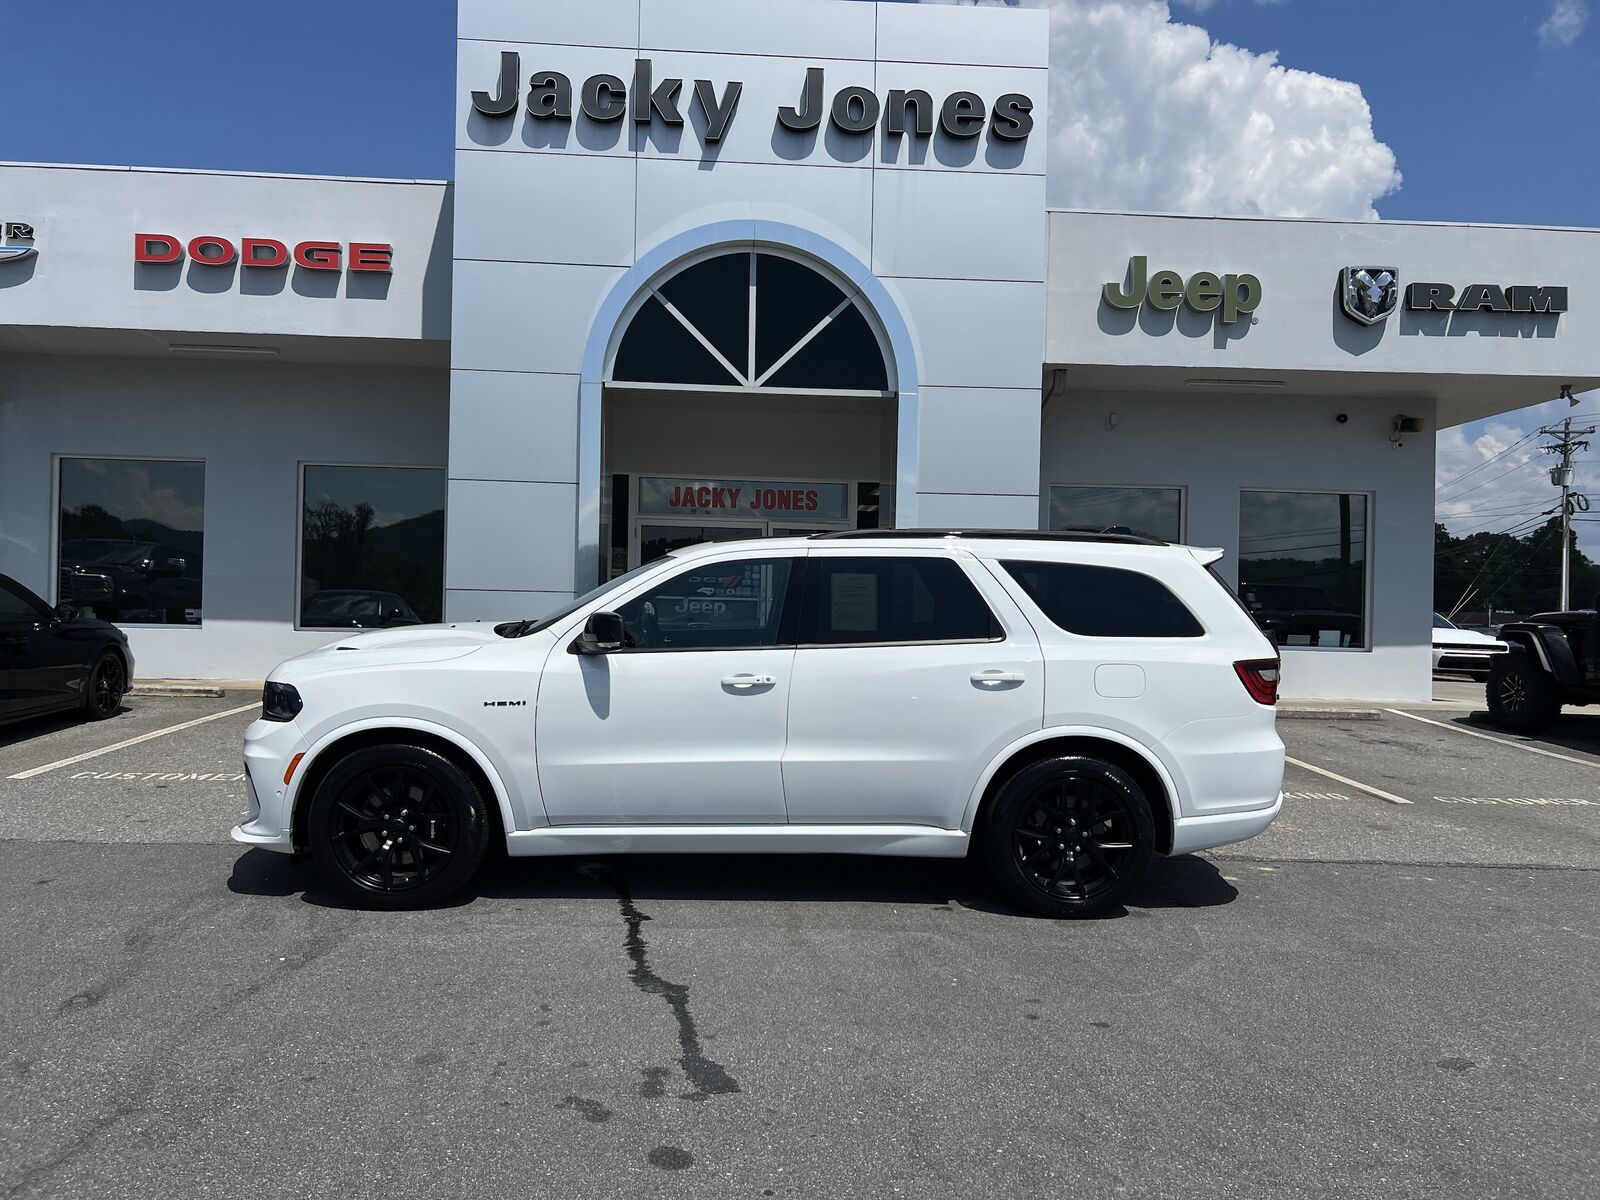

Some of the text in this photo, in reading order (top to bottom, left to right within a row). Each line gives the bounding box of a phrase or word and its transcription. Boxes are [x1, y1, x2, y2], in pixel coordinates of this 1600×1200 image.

[471, 51, 1033, 144] Jacky Jones
[0, 222, 35, 240] R
[135, 233, 393, 273] DODGE
[1103, 256, 1262, 323] Jeep
[1406, 282, 1568, 313] RAM
[669, 486, 818, 511] JACKY JONES
[674, 596, 727, 616] Jeep
